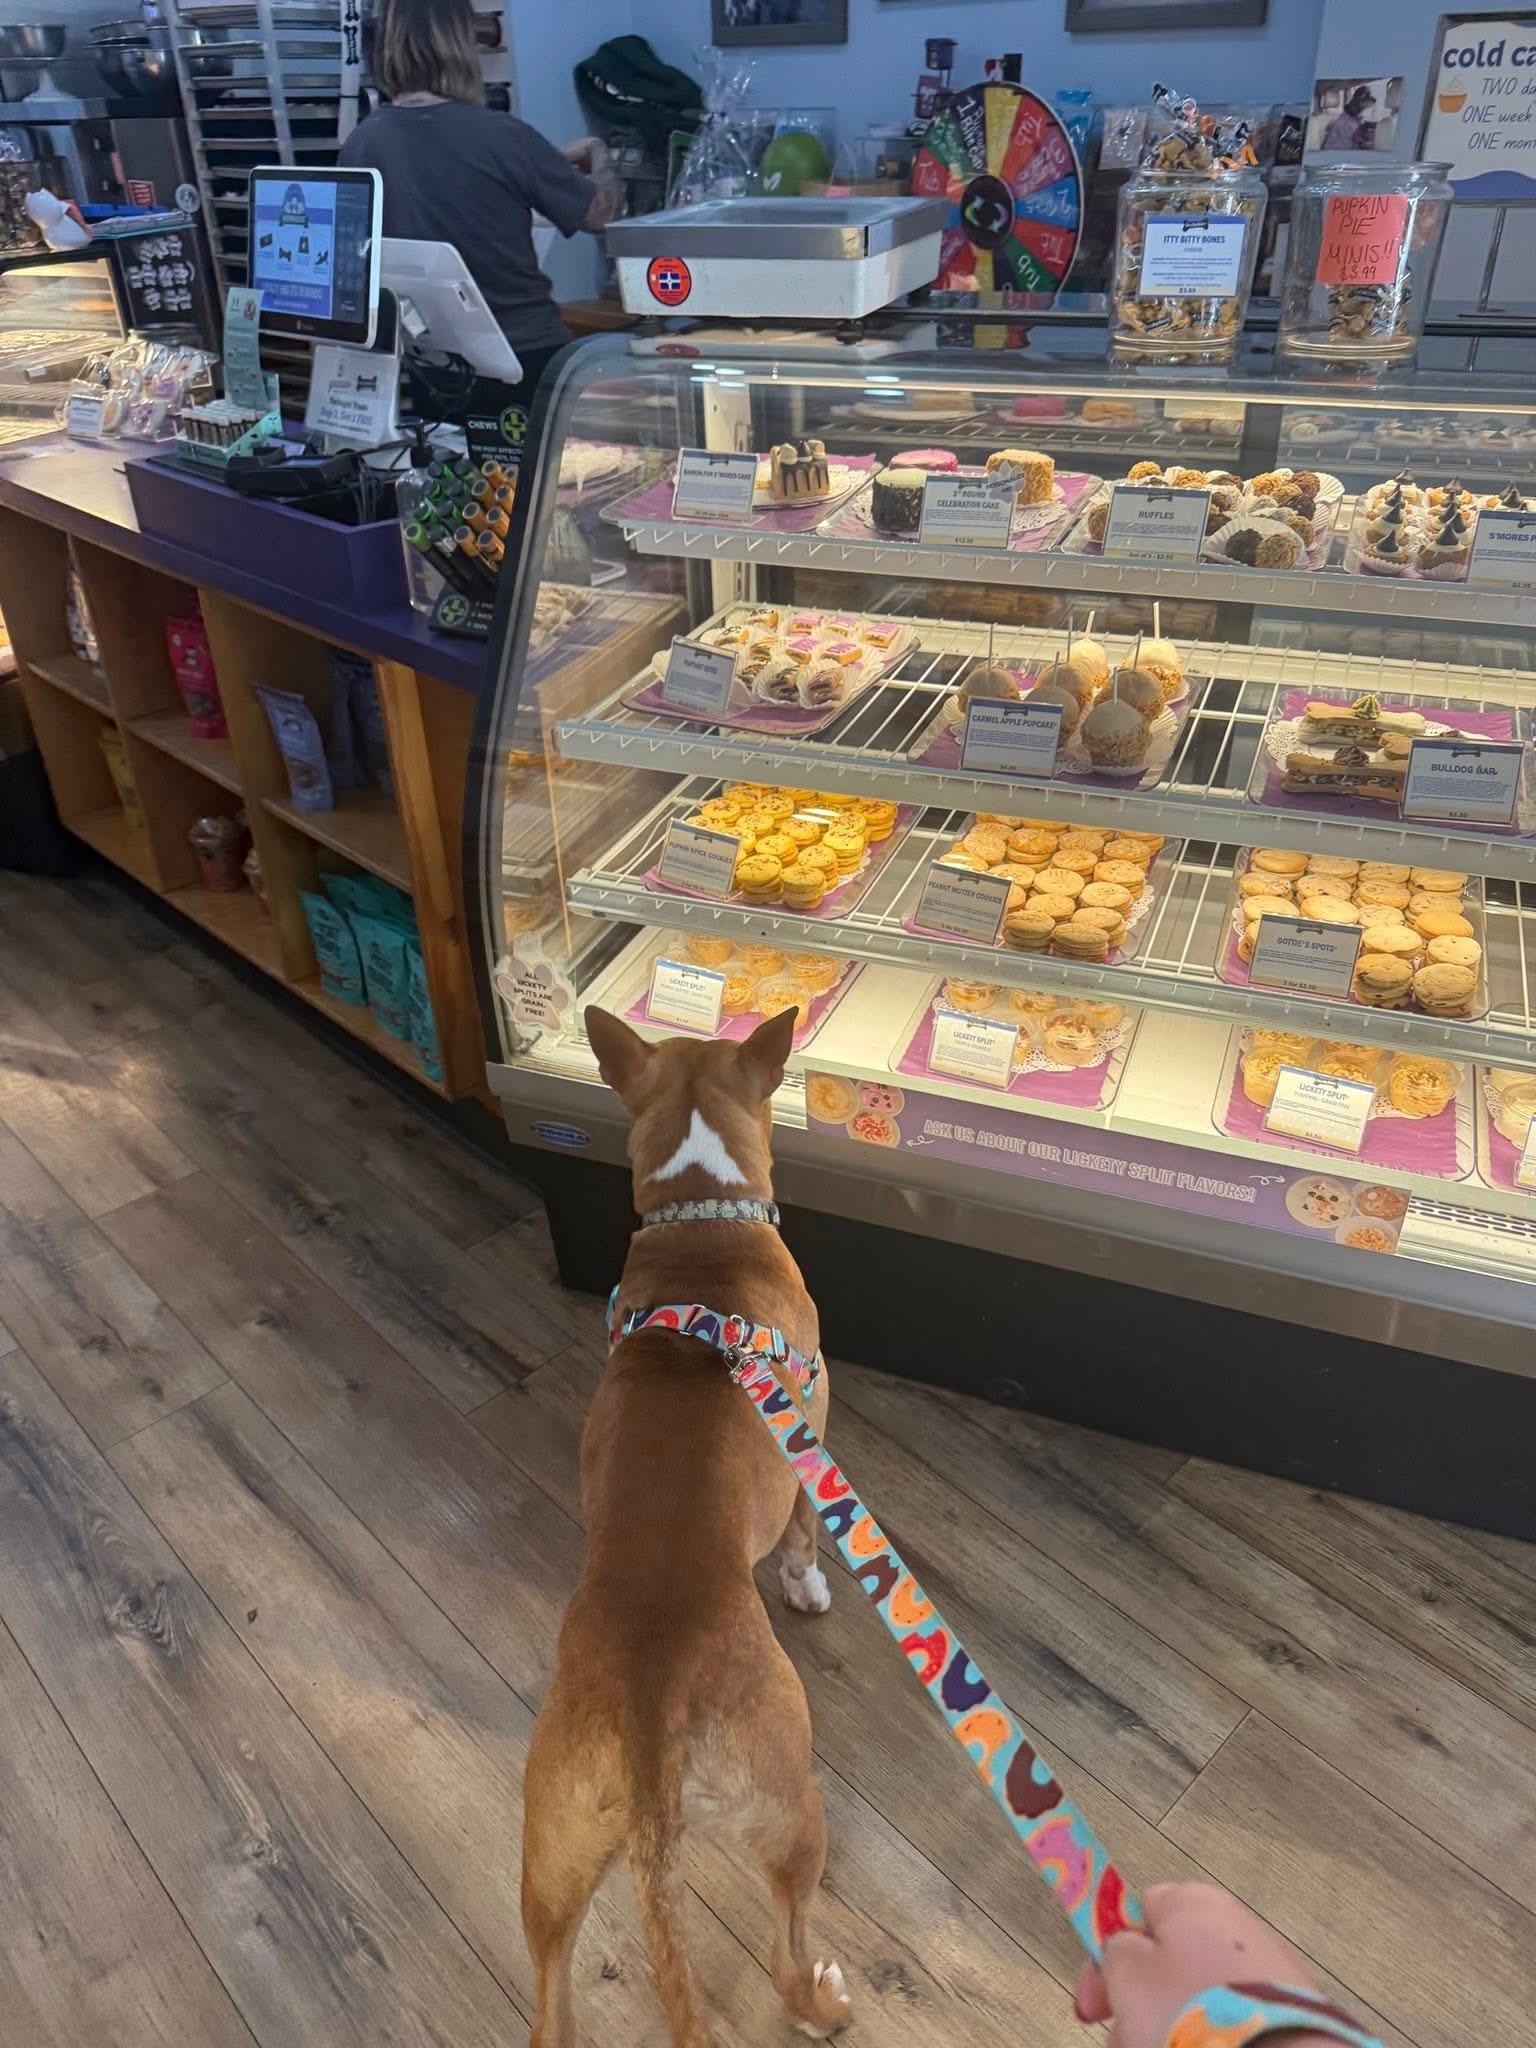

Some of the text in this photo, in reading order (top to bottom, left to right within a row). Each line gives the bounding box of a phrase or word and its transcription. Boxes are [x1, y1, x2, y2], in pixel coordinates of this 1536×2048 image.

[1443, 39, 1506, 69] cold
[1481, 77, 1518, 95] TWO
[1463, 104, 1533, 123] ONE week
[1468, 132, 1502, 150] ONE
[1339, 215, 1377, 236] PIE
[1163, 235, 1226, 245] ITTY BITTY BONES
[468, 420, 498, 430] CHEWS
[937, 499, 1000, 509] CELEBRATION CAKE
[1138, 510, 1176, 520] RUFFLES
[1489, 532, 1529, 542] S'MORES
[972, 714, 1000, 724] CARMEL
[1000, 718, 1021, 727] APPLE
[1431, 763, 1474, 774] BULLDOG
[708, 852, 733, 865] COOKIES
[928, 880, 952, 892] PEANUT
[976, 891, 1003, 905] COOKIES
[1277, 936, 1311, 949] DOTTIE'S
[525, 971, 538, 980] ALL
[513, 986, 552, 1002] SPLITS ARE
[525, 1007, 545, 1017] FREE!
[953, 1031, 977, 1042] LICKETY
[1299, 1083, 1327, 1095] LICKETY
[923, 1119, 1258, 1204] ASK US ABOUT OUR LICKETY SPLIT FLAVORS!
